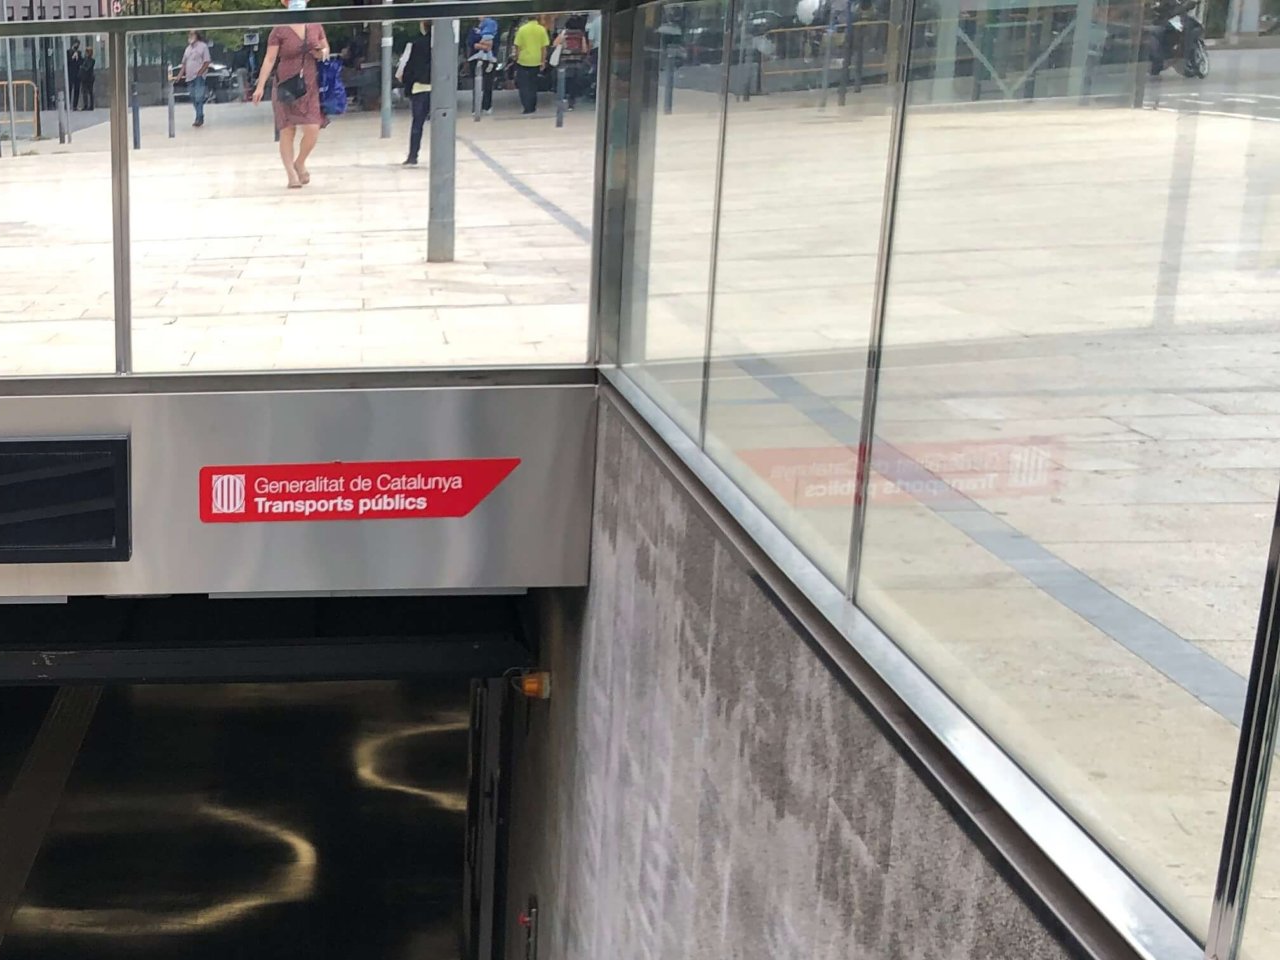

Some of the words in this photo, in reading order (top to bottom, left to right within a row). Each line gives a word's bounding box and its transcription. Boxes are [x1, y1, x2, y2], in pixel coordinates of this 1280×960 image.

[254, 475, 345, 494] Generalitat
[350, 474, 372, 491] de
[377, 473, 462, 493] Catalunya
[254, 496, 354, 516] Transports
[359, 494, 428, 515] públics
